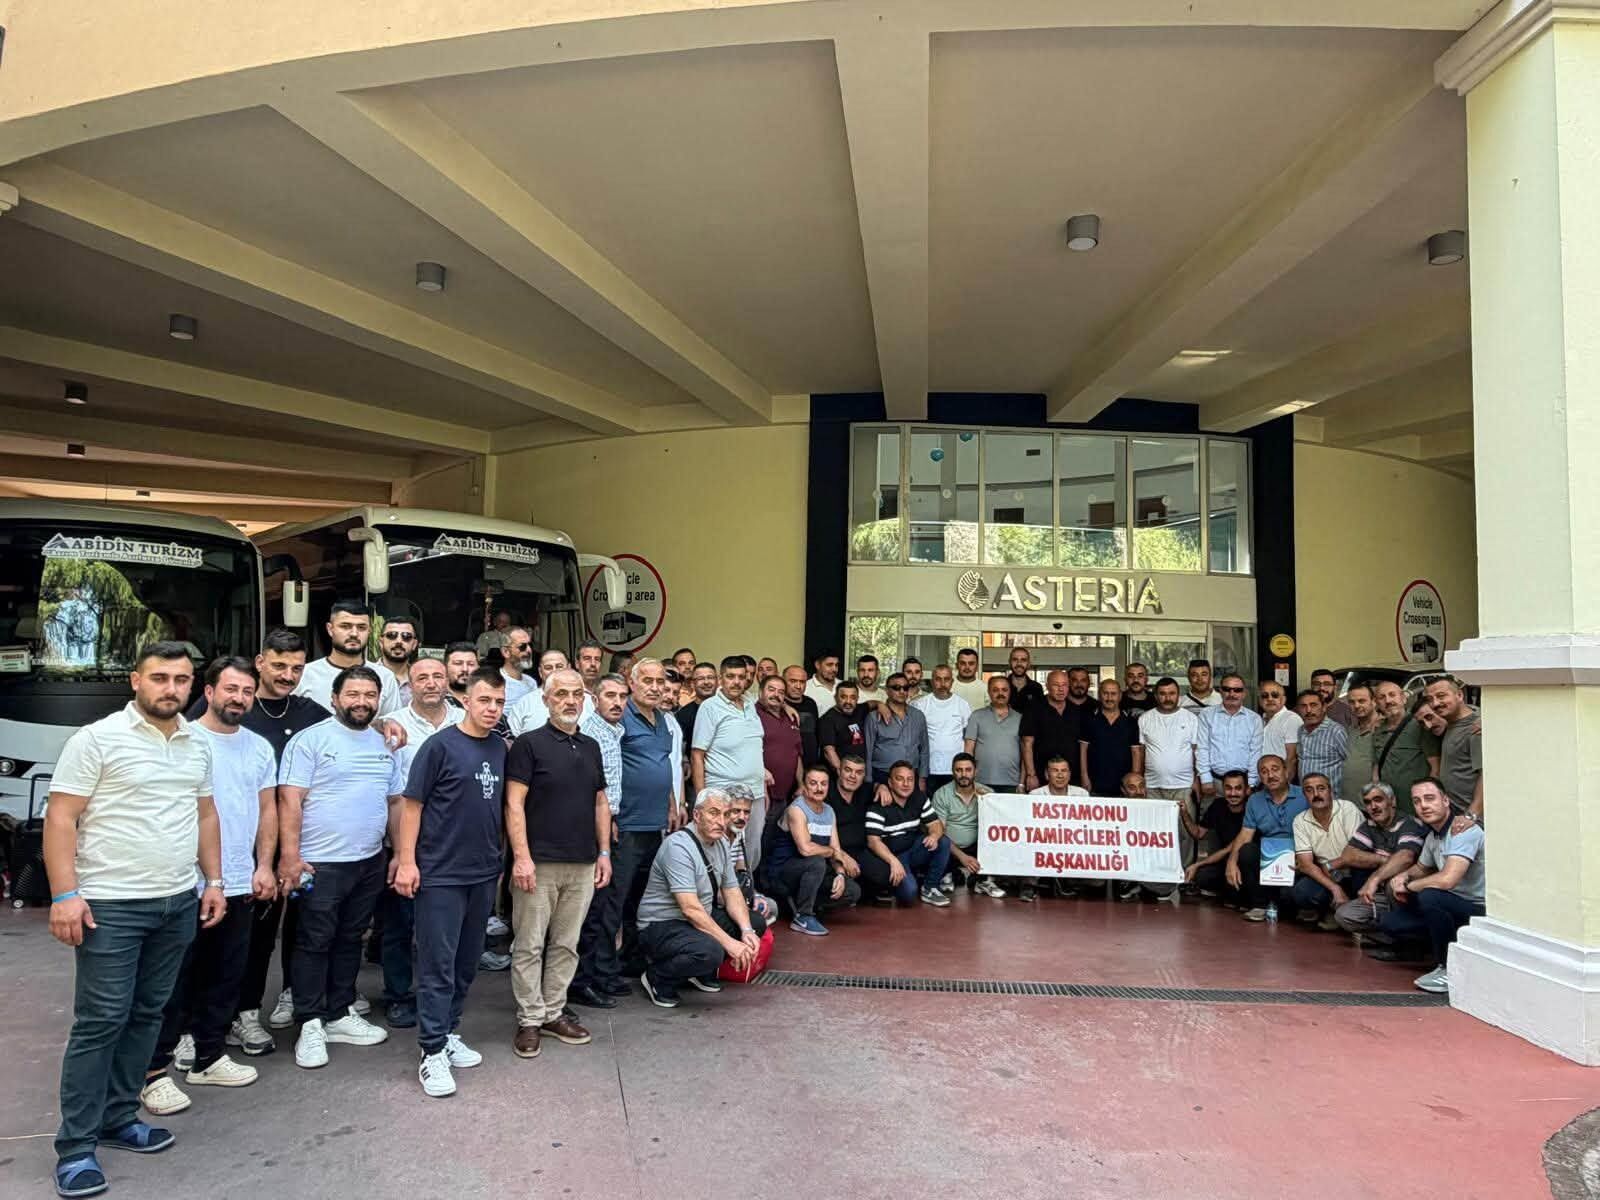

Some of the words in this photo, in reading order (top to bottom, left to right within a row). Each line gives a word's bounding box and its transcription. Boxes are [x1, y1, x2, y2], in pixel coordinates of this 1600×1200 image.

[71, 537, 134, 553] ABİDİN
[139, 543, 200, 560] TURİZM
[453, 537, 494, 551] ABİDİN
[496, 544, 537, 557] TURİZM
[592, 588, 633, 604] Crog
[634, 591, 656, 601] area
[992, 572, 1163, 614] ASTERIA
[1412, 594, 1433, 609] Vehicle
[1403, 611, 1430, 628] Crossing
[1031, 802, 1128, 823] KASTAMONU
[987, 825, 1020, 843] OTO
[1024, 824, 1121, 847] TAMİRCİLERİ
[1125, 831, 1174, 849] ODASI
[1034, 850, 1129, 873] BAŞKANLIĞI
